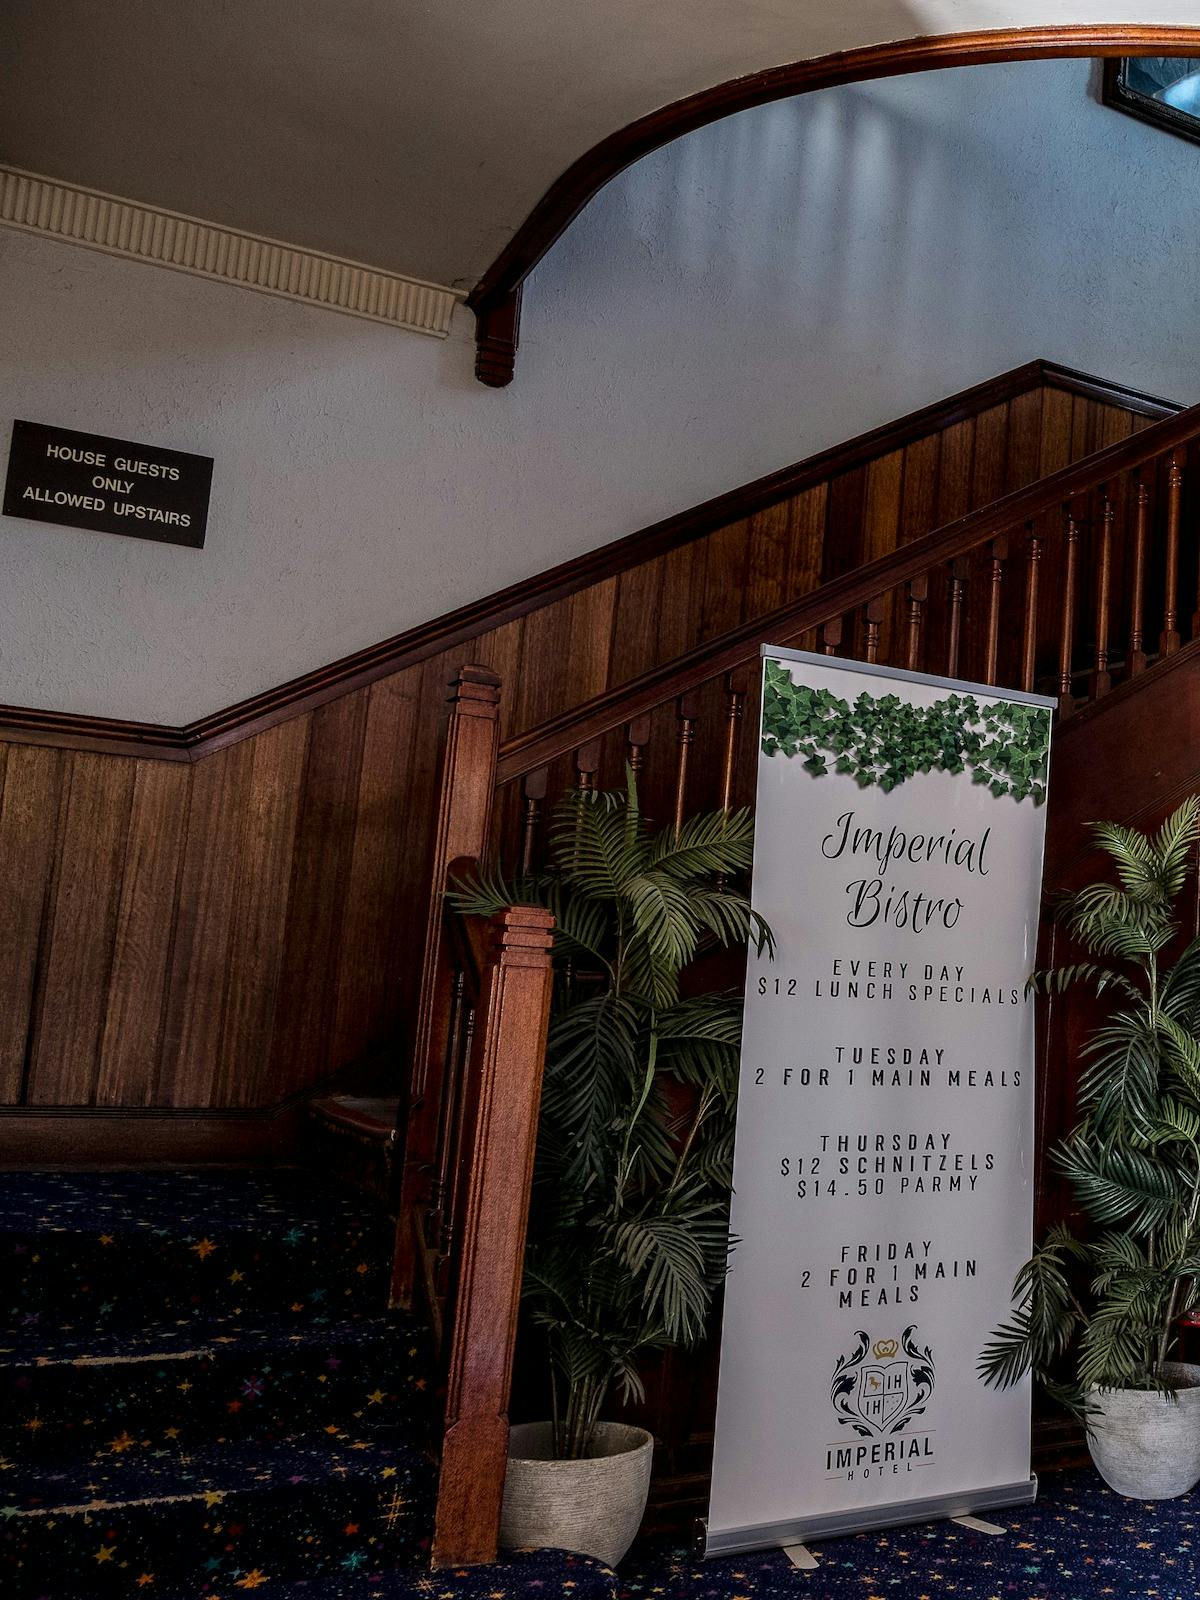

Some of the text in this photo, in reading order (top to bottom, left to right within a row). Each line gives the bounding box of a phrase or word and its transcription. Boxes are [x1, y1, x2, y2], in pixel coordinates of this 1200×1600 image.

[47, 444, 180, 481] HOUSE GUESTS
[92, 476, 135, 494] ONLY
[22, 486, 191, 527] ALLOWED UPSTAIRS
[821, 811, 992, 876] Imperial
[845, 879, 964, 934] Bistro
[833, 959, 964, 982] EVERY DAY
[758, 976, 1018, 1005] $12 LUNCH SPECIALS
[836, 1046, 945, 1066] TUESDAY
[755, 1067, 1021, 1088] 2 FOR 1 MAIN MEALS
[820, 1133, 952, 1153] THURSDAY
[780, 1153, 995, 1177] $12 SCHNITZELS
[797, 1175, 979, 1199] $14.50 PARMY
[841, 1241, 932, 1263] FRIDAY
[801, 1260, 977, 1288] 2 FOR 1 MAIN
[838, 1285, 920, 1309] MEALS
[826, 1437, 934, 1470] IMPERIAL
[847, 1463, 913, 1480] HOTEL
